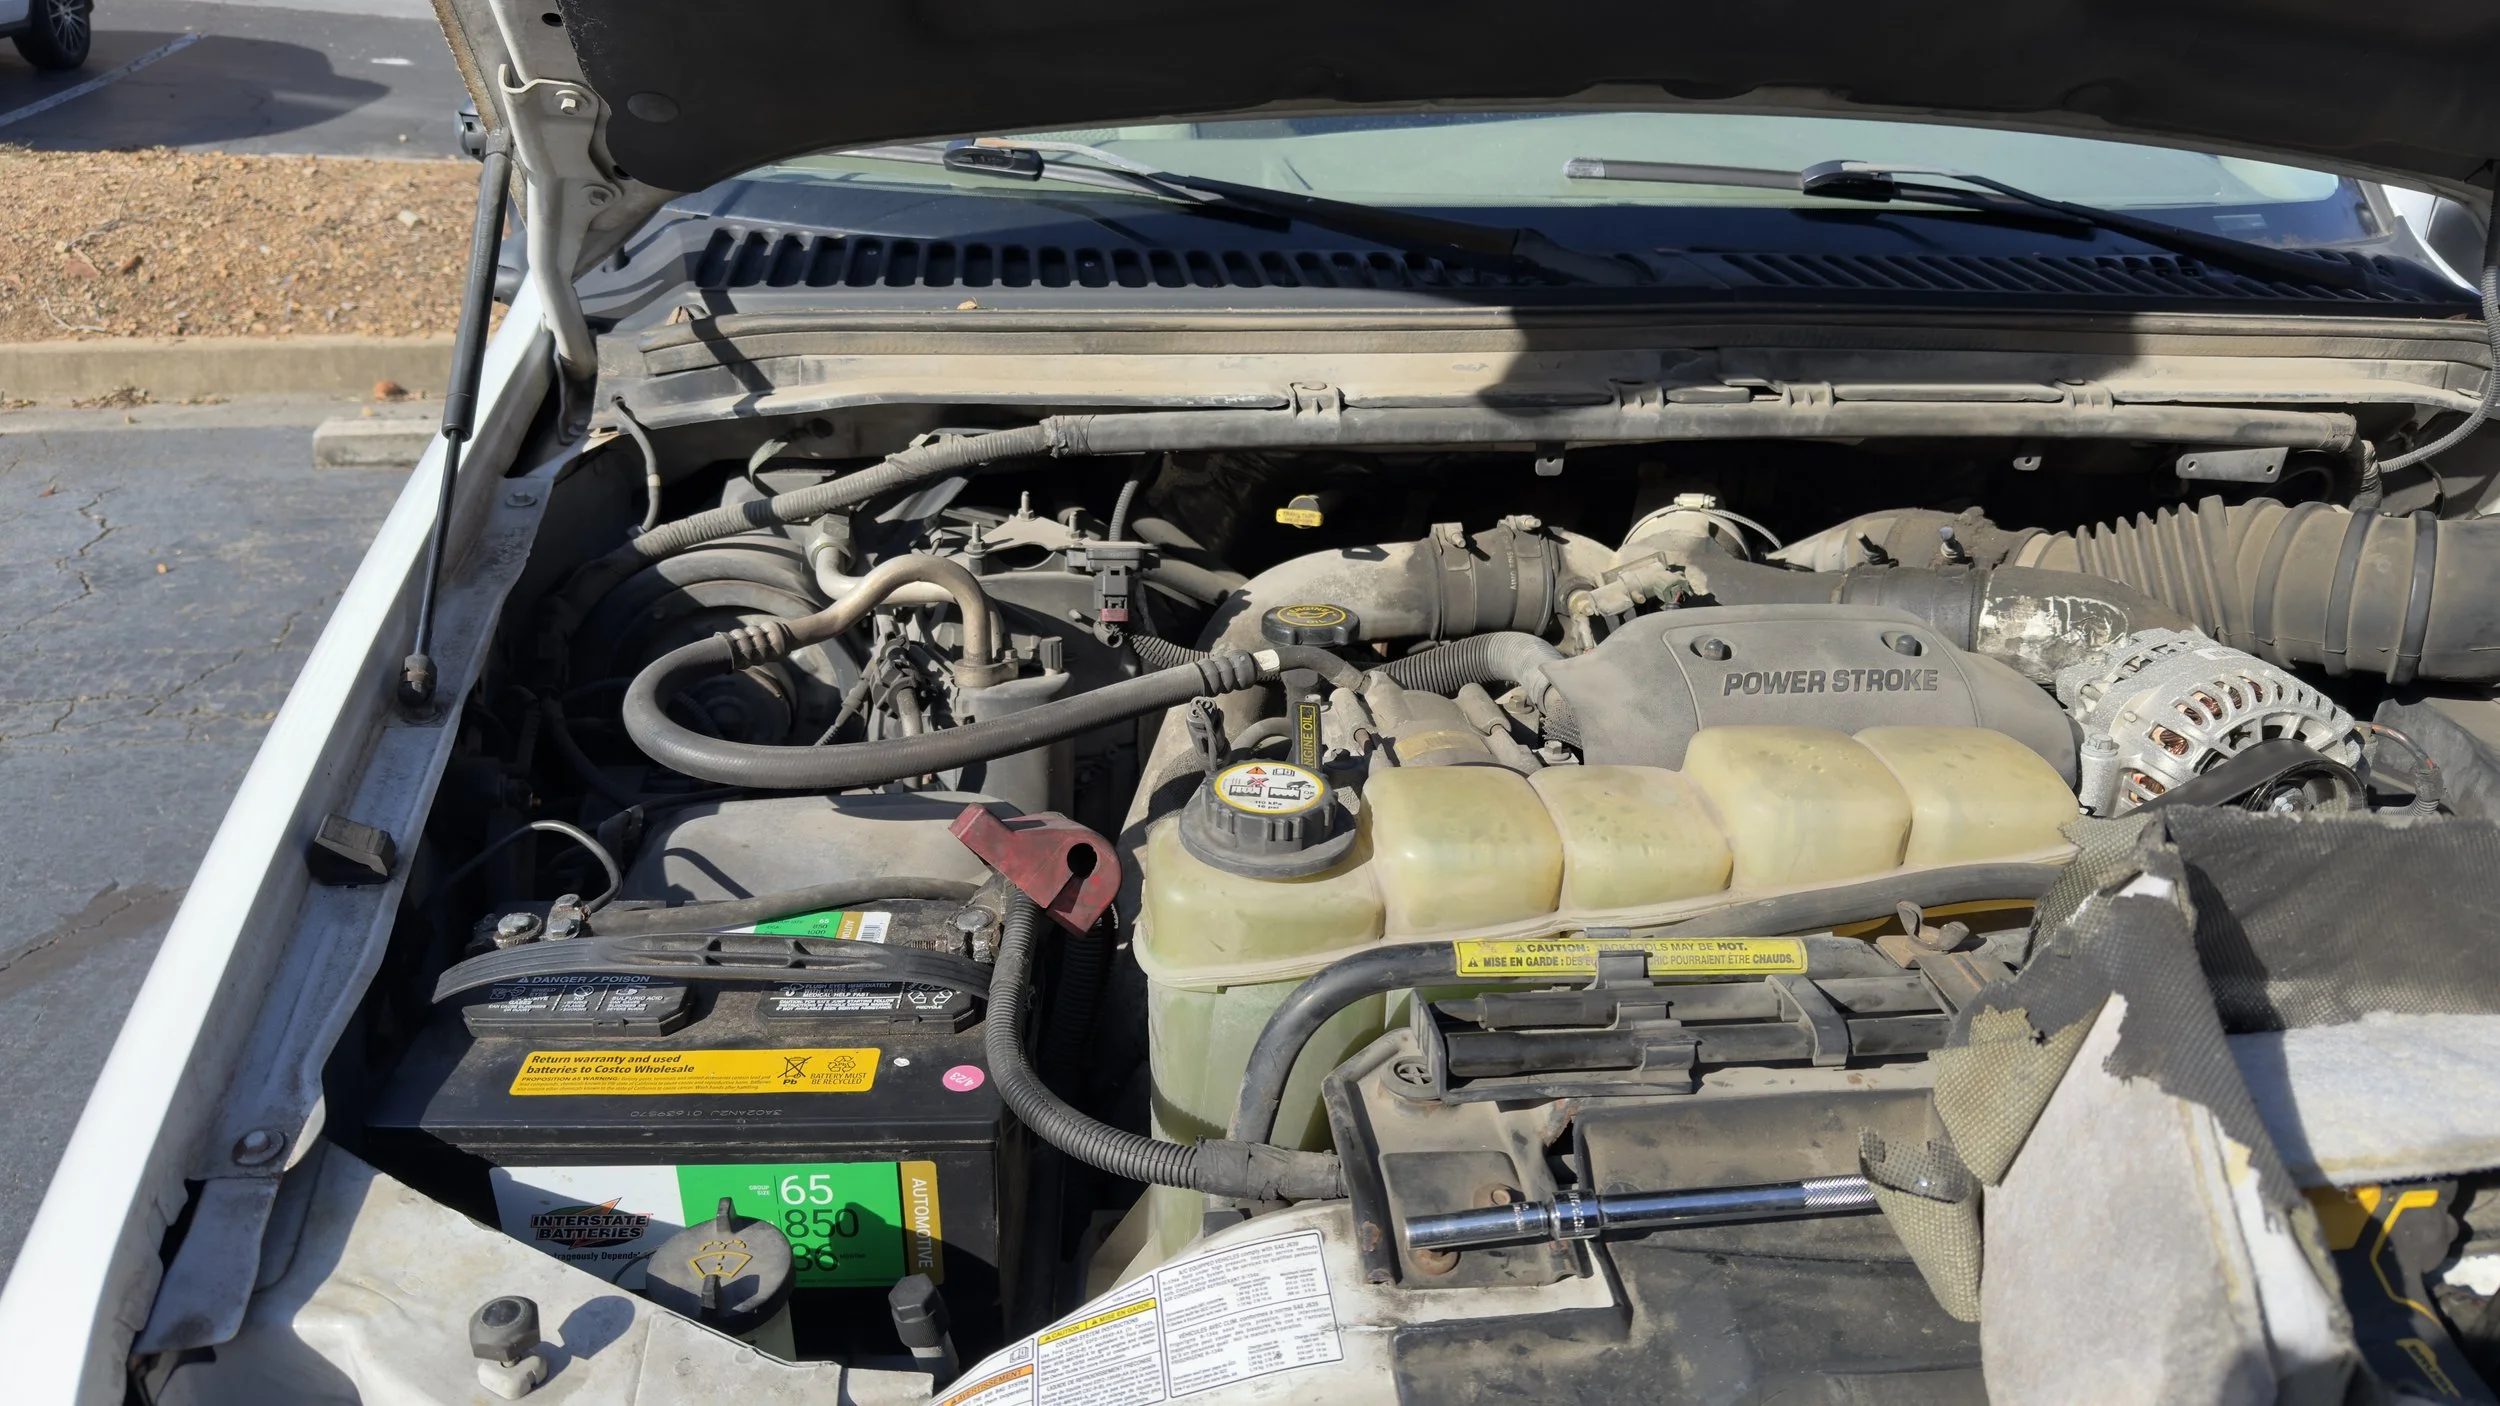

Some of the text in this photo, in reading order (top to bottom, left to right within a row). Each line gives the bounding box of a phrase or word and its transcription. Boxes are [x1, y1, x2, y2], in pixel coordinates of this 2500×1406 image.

[1723, 669, 1938, 696] POWER STROKE
[1303, 714, 1313, 768] NGINE OIL
[1527, 943, 1590, 953] CAUTION:
[1629, 943, 1667, 951] TOOLS
[1717, 942, 1748, 951] HOT.
[1483, 957, 1508, 968] MISE
[1509, 957, 1524, 967] EN
[1565, 957, 1582, 967] DES
[1671, 954, 1725, 965] POURRAIENT
[1753, 953, 1795, 964] CHAUDS.
[532, 1055, 681, 1065] Return warranty and used
[526, 1065, 694, 1074] batteries to Costco Wholesale
[781, 1174, 833, 1205] 65
[533, 1215, 648, 1226] INTERSTATE
[785, 1208, 859, 1238] 850
[912, 1177, 934, 1268] AUTOMOTIVE
[539, 1228, 642, 1239] BATTERIES
[551, 1252, 598, 1261] trageously
[1215, 1253, 1240, 1264] VEHICLES
[1051, 1325, 1080, 1339] CAUTION
[1099, 1314, 1115, 1322] MISE
[1127, 1302, 1150, 1314] GARDE
[1055, 1317, 1139, 1348] COOLING SYSTEM INSTRUCTIONS
[958, 1369, 1023, 1400] AVERTISSEMENT
[1007, 1379, 1029, 1389] SYSTEM
